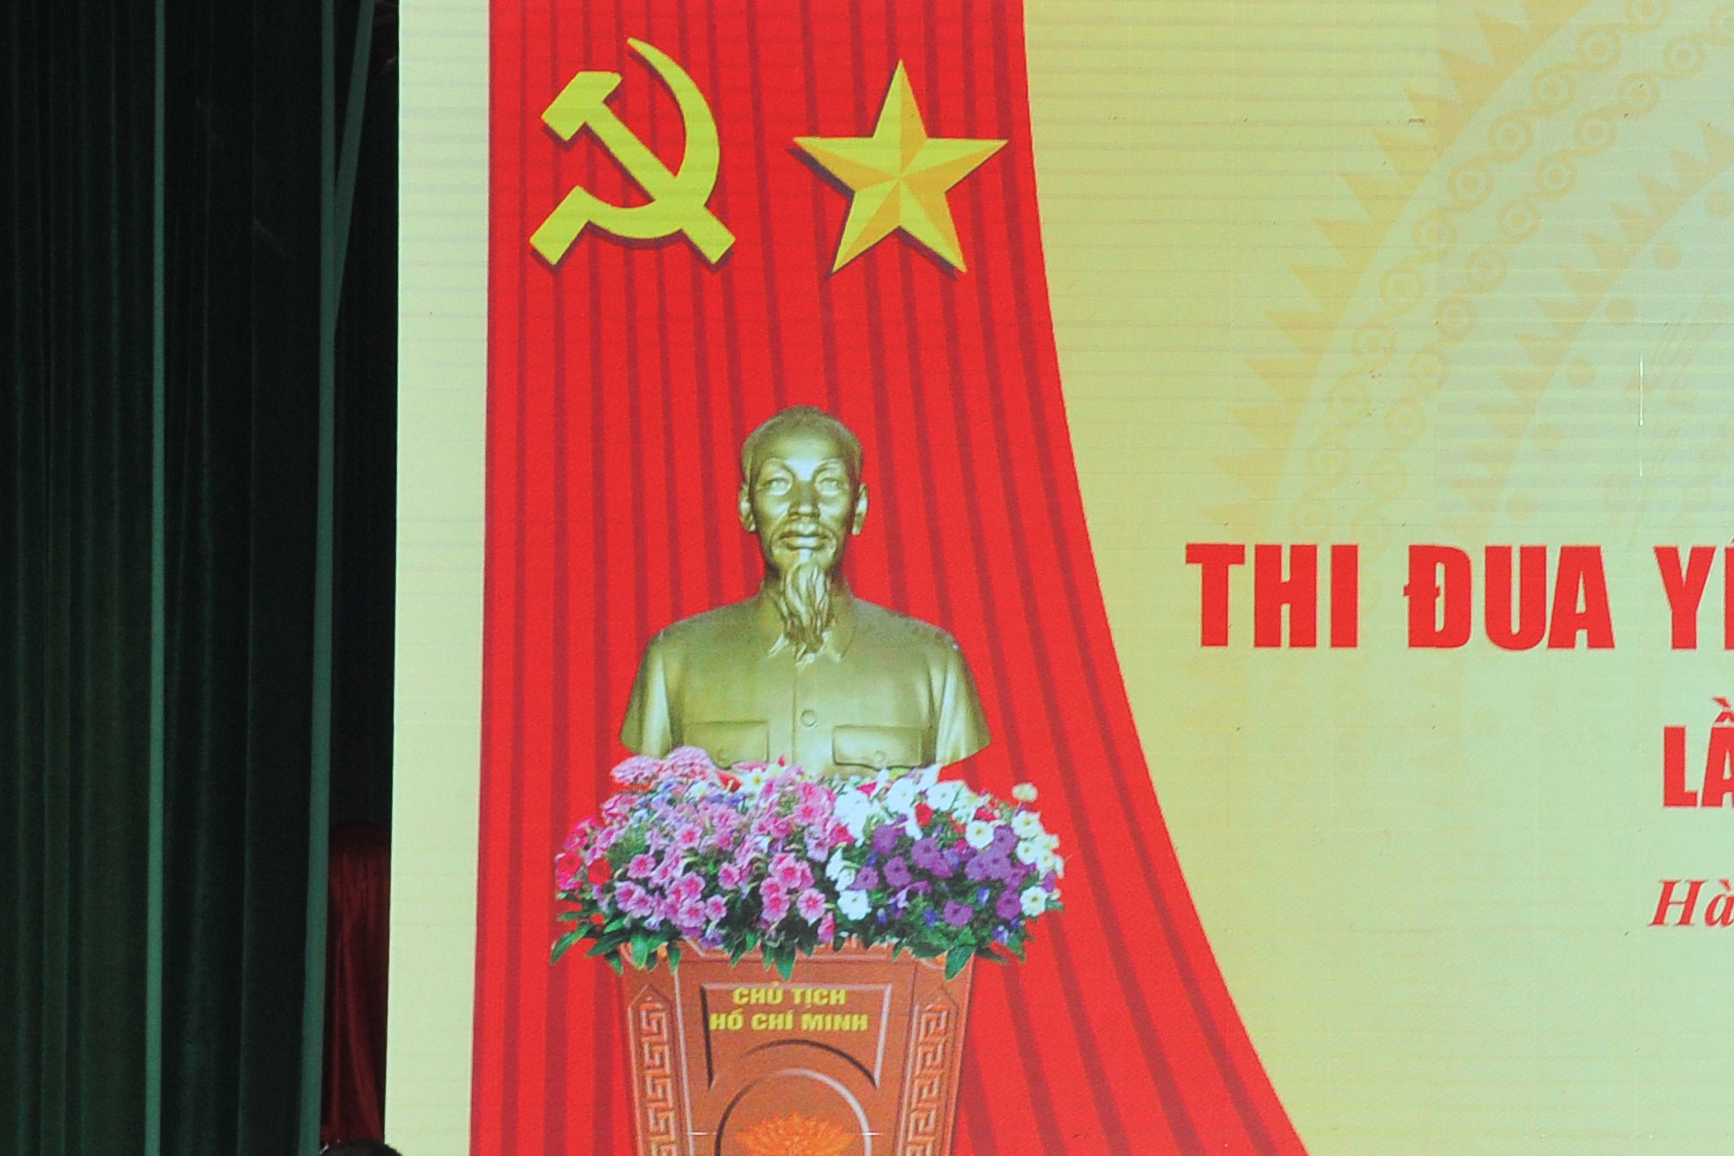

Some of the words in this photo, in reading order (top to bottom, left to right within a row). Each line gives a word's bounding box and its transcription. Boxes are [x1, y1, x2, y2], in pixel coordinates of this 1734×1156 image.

[1185, 543, 1359, 649] THI
[1403, 544, 1615, 651] ĐUA
[733, 982, 783, 1005] CHỦ
[792, 988, 846, 1008] TỊCH
[751, 1009, 794, 1031] CHÍ
[802, 1013, 868, 1031] MINH
